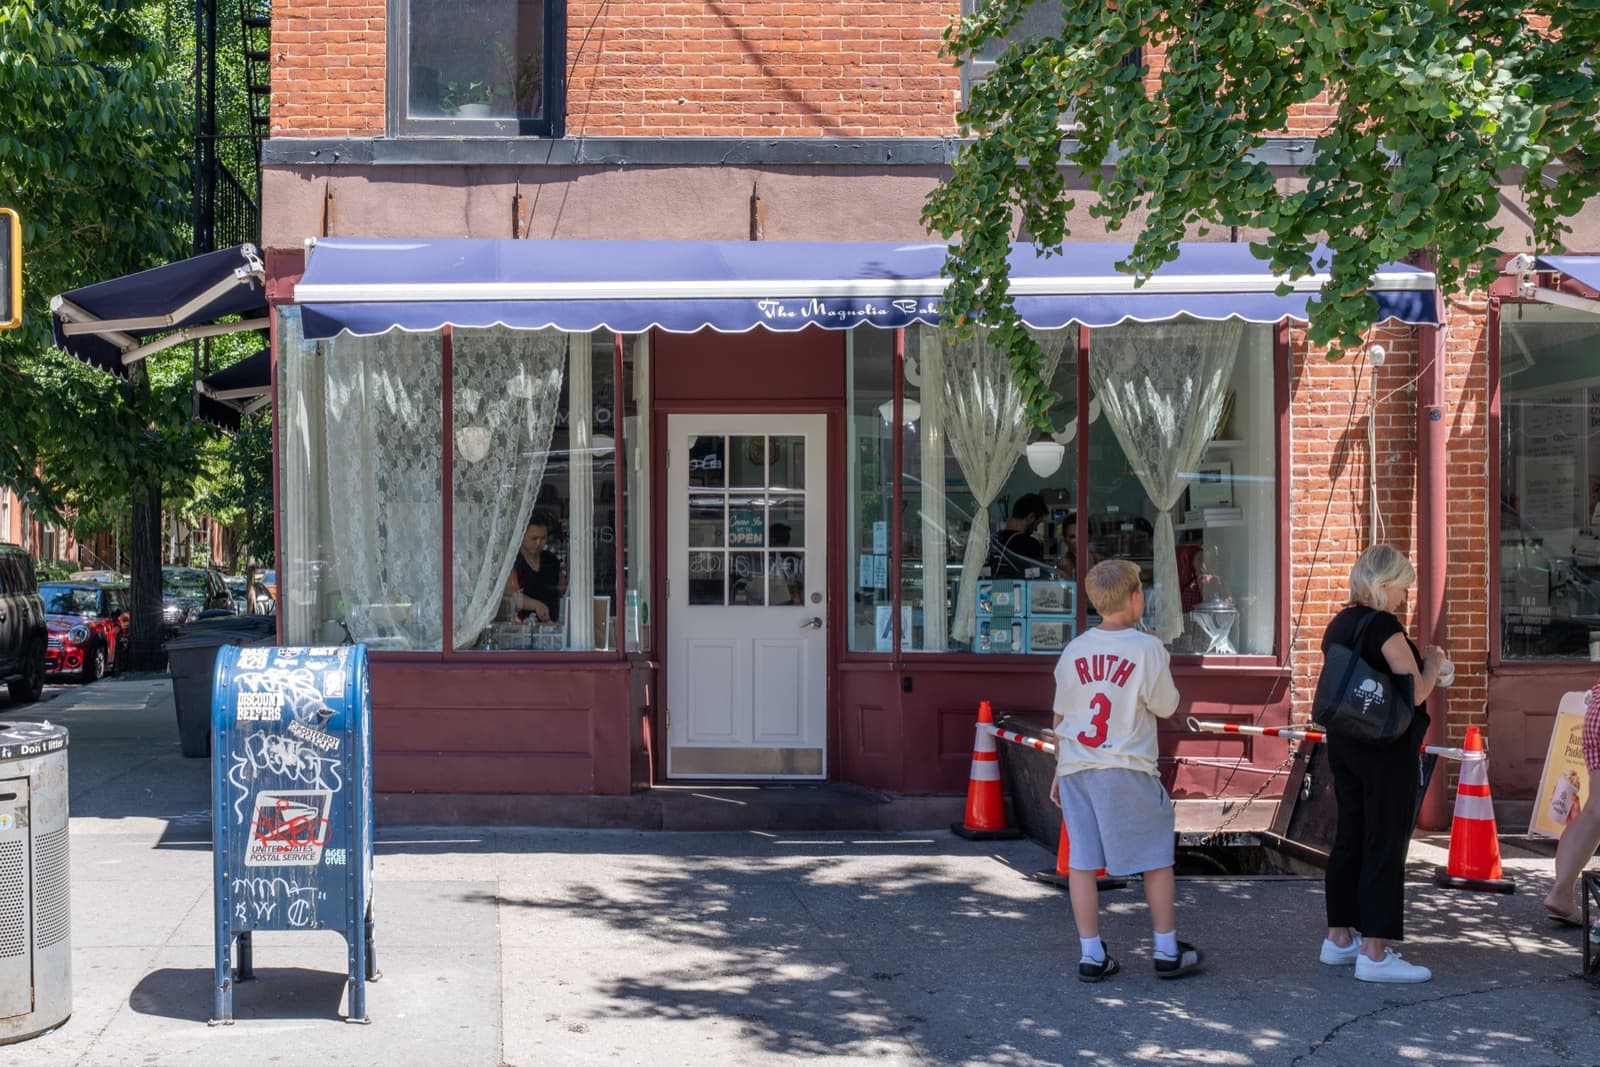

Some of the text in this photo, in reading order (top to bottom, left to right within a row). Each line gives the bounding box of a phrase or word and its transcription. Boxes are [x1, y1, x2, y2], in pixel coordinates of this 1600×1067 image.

[758, 298, 940, 320] The Magnolia Bak
[729, 533, 763, 545] OPEN
[1074, 654, 1137, 689] RUTH
[238, 692, 284, 706] DISCOUNT
[237, 706, 281, 720] BEEPERS
[1077, 692, 1112, 749] 3
[20, 742, 47, 755] Dont
[252, 845, 314, 853] UNITED STATES
[250, 853, 317, 862] POSTAL SERVICE
